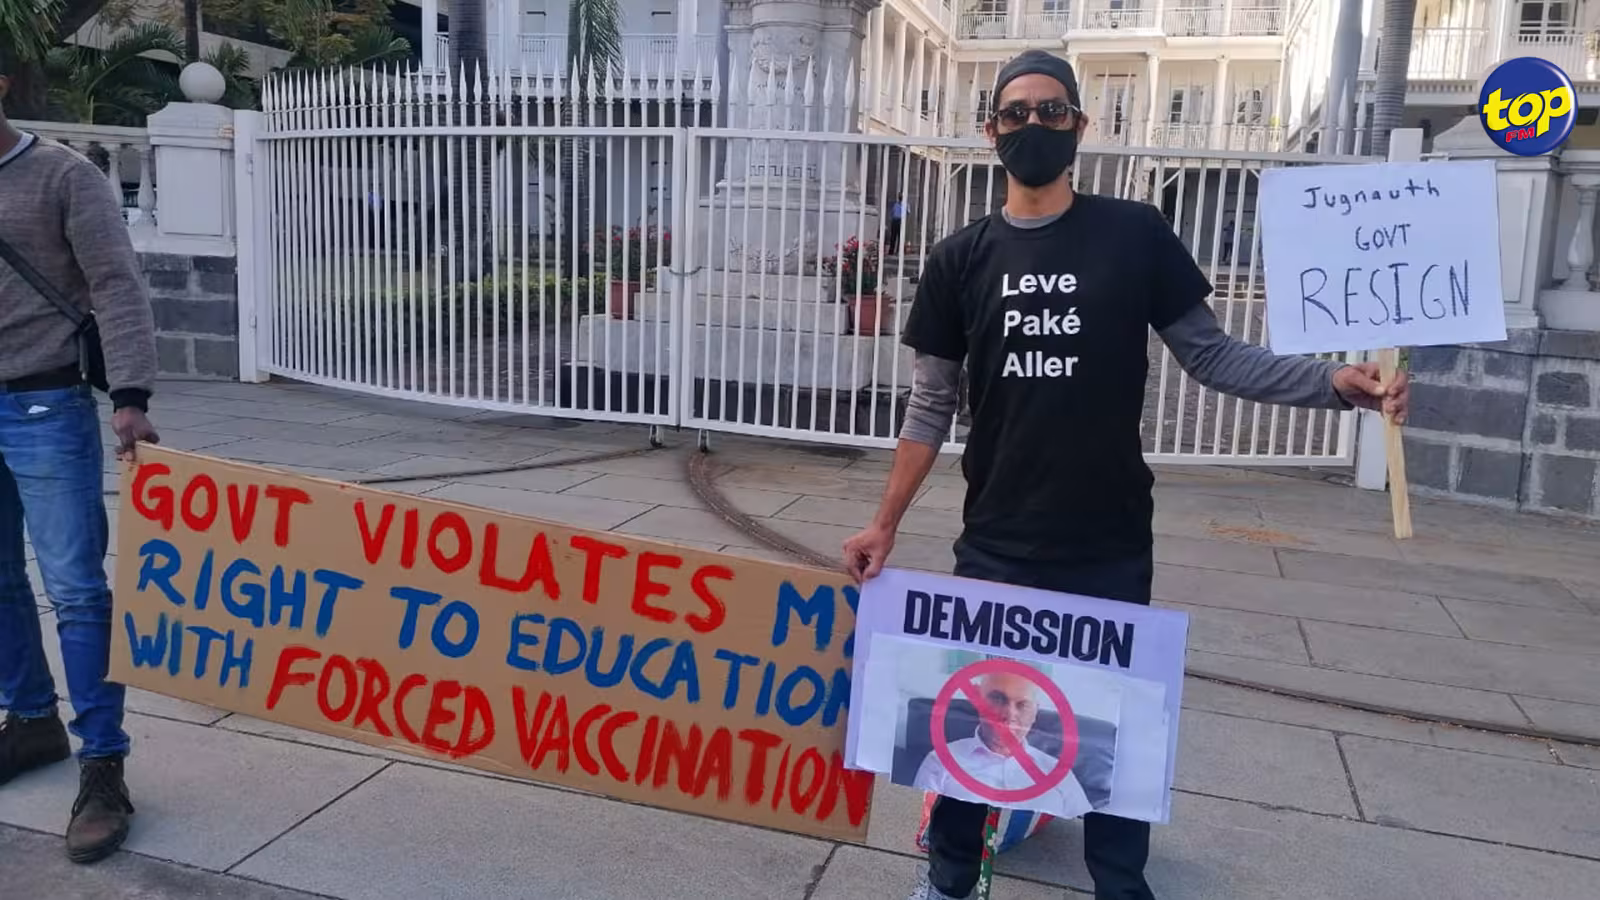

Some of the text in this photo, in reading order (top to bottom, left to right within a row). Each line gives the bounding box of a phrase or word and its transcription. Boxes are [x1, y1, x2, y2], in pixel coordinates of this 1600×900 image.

[1303, 179, 1440, 215] Jugnauth
[1355, 224, 1411, 251] GOVT
[1001, 273, 1077, 297] Leve
[1300, 260, 1469, 332] RESIGN
[1004, 307, 1081, 337] Paké
[1001, 351, 1079, 377] Aller
[131, 462, 313, 547] GOVT
[354, 498, 735, 633] VIOLATES
[137, 539, 364, 638] RIGHT
[390, 586, 480, 658] TO
[903, 589, 1134, 668] DEMISSION
[124, 611, 875, 827] WITH FORCED VACCINATION
